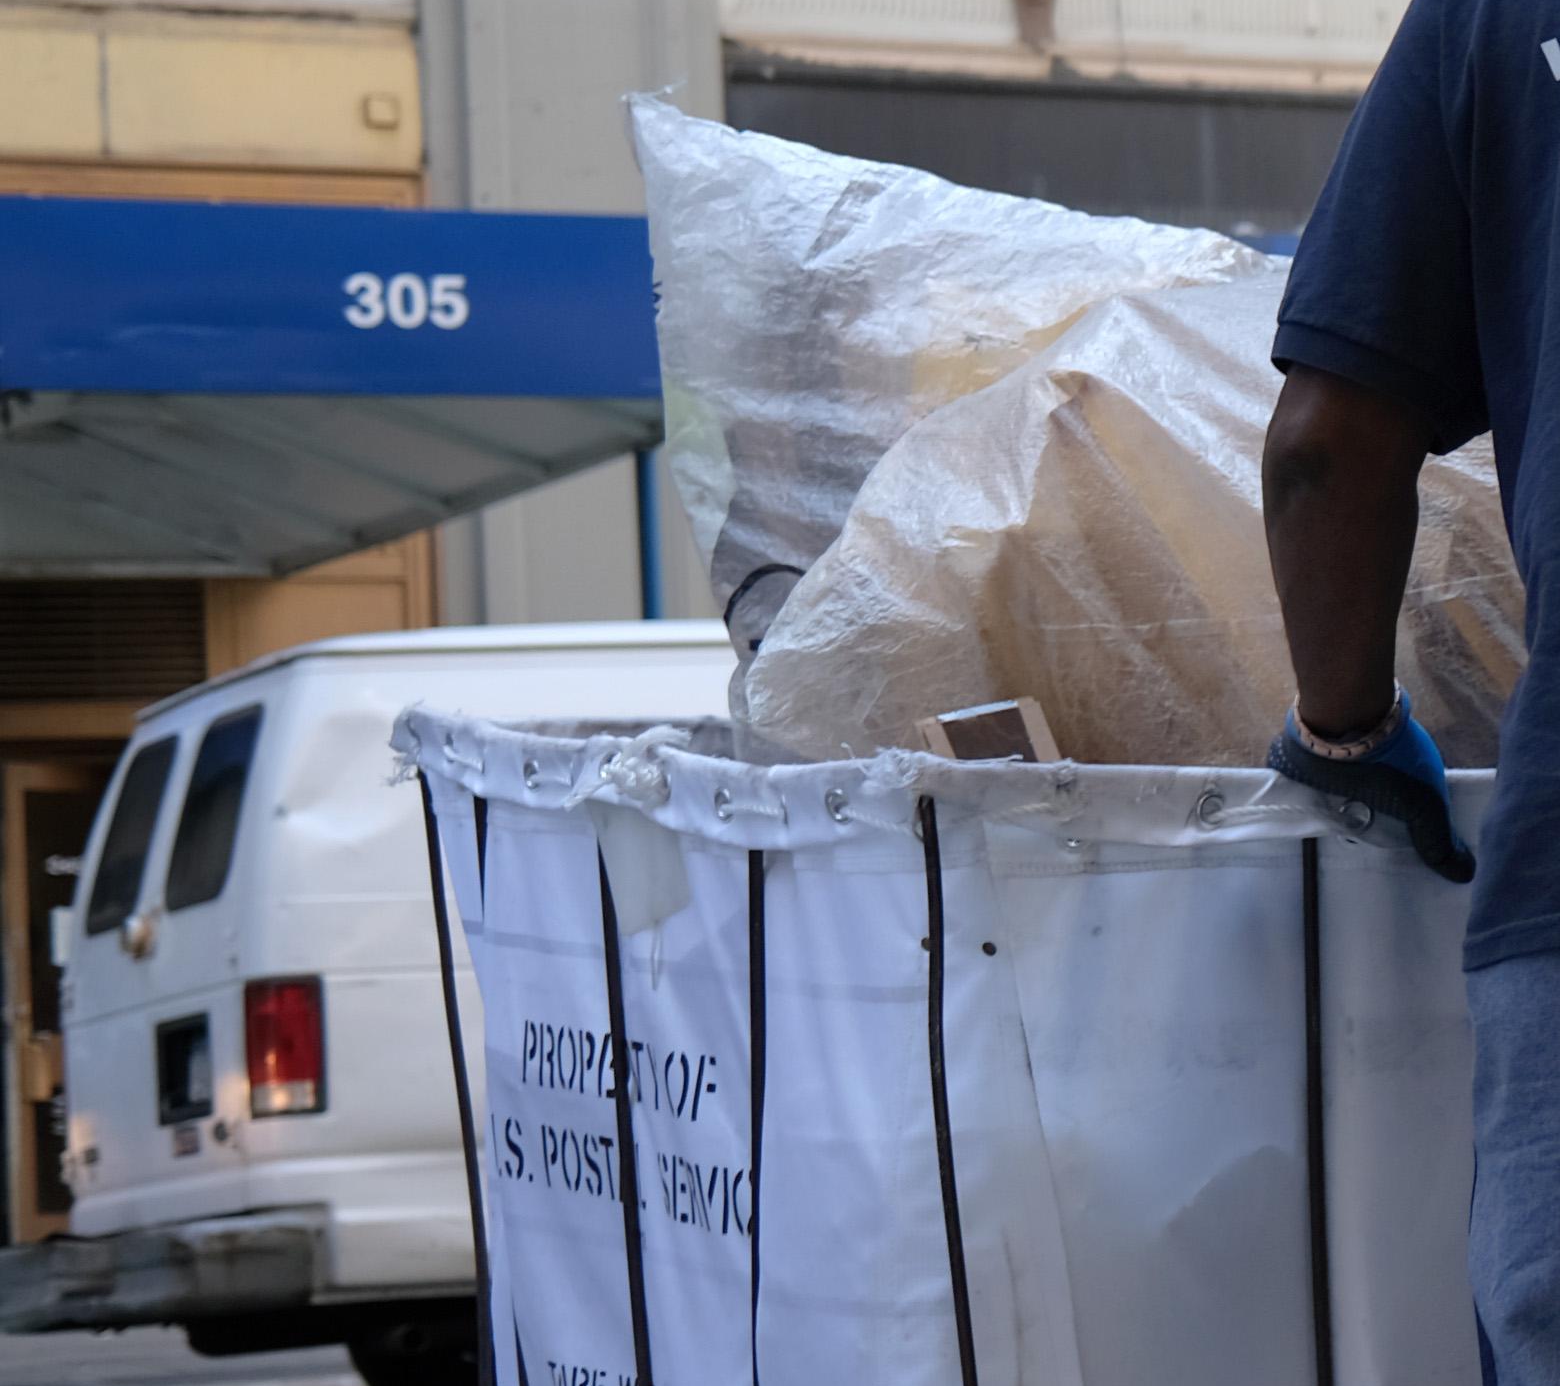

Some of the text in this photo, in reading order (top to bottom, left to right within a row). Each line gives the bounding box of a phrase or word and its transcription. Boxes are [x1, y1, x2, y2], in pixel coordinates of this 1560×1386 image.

[343, 273, 469, 330] 305
[664, 1051, 717, 1121] OF
[541, 1124, 647, 1210] POSTL
